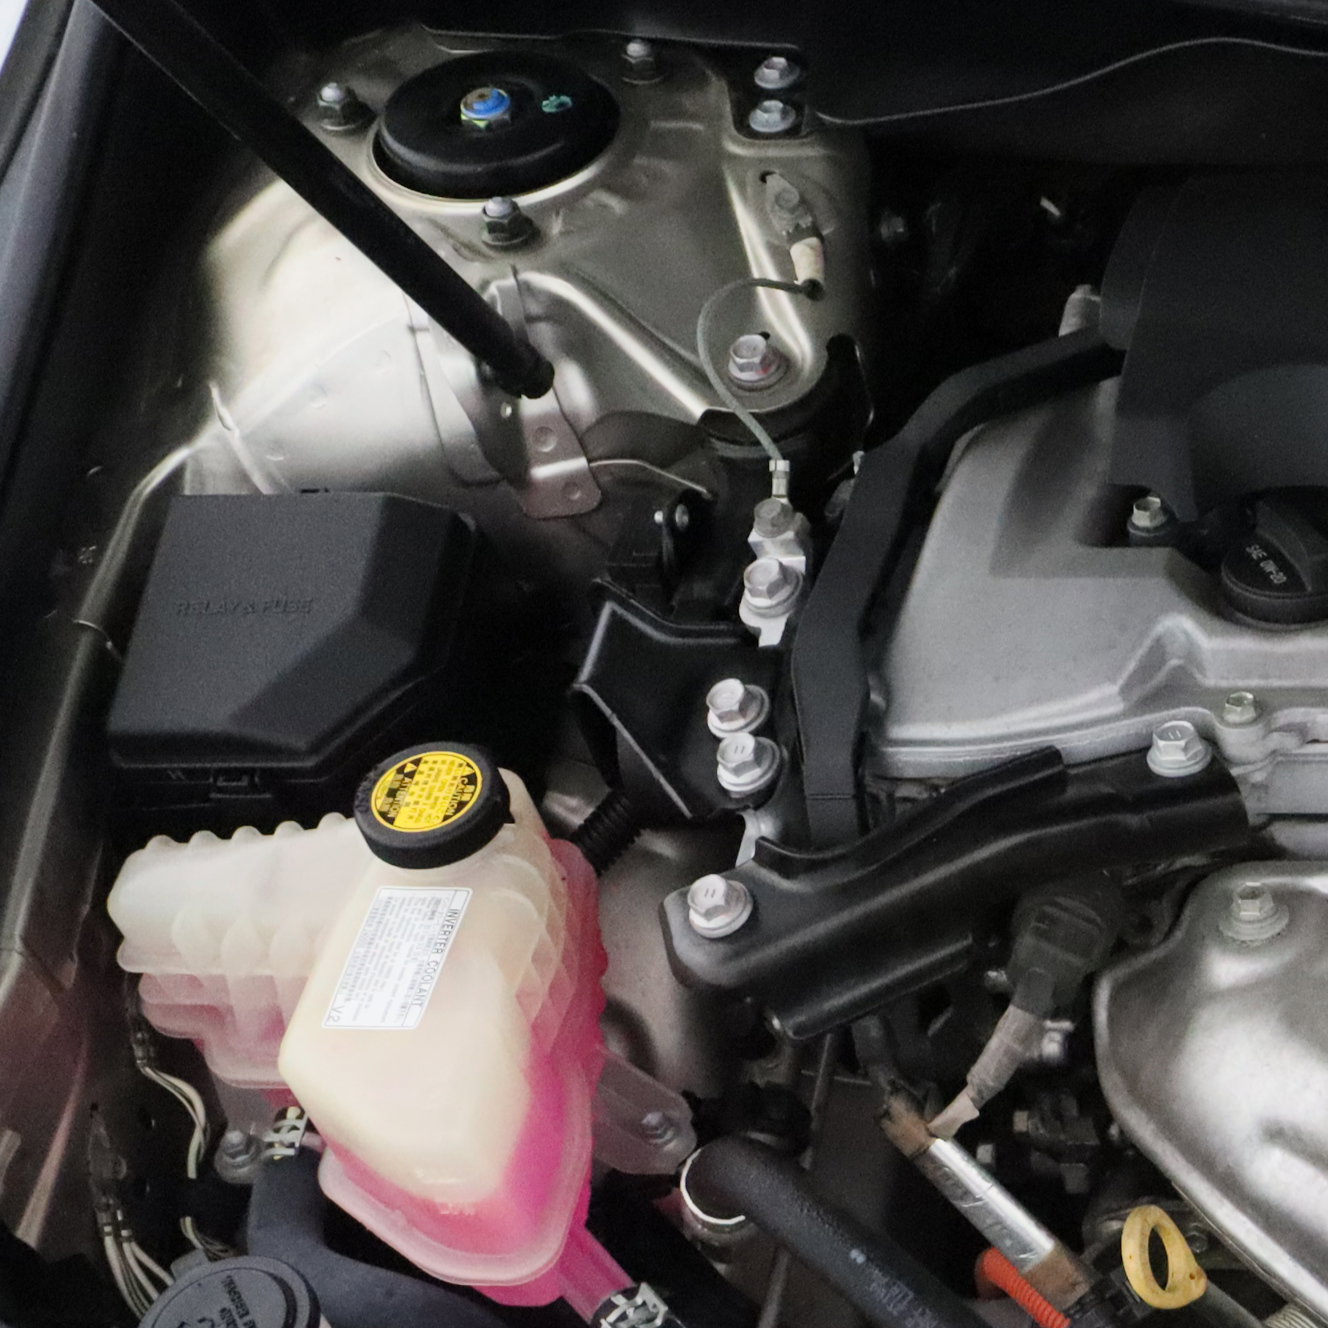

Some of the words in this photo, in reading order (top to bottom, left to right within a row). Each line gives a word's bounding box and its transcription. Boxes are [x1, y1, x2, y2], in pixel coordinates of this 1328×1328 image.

[1245, 544, 1268, 560] SAE
[387, 776, 413, 818] ATTENTION
[447, 776, 469, 816] CAUTION
[432, 908, 460, 955] INVERTER
[411, 960, 440, 1007] COOLANT
